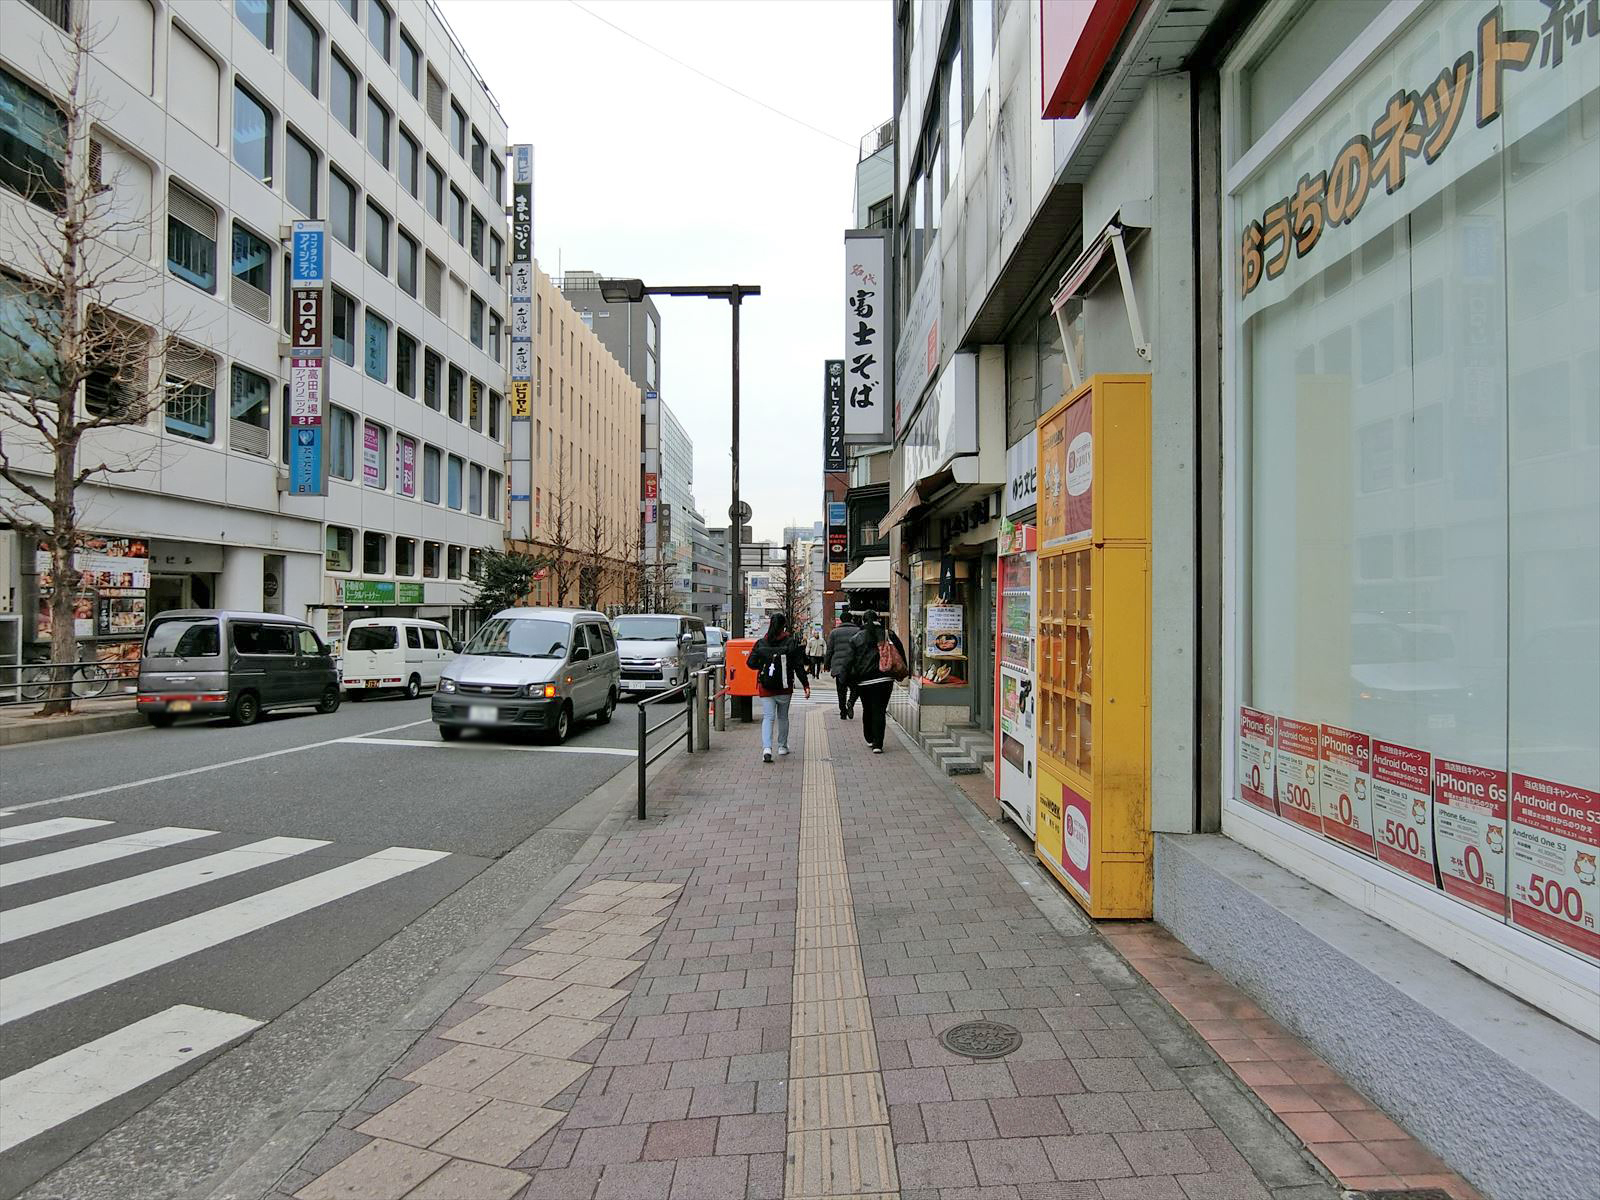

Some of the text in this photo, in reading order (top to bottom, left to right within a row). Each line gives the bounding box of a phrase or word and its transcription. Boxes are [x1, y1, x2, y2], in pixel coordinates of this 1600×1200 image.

[1242, 5, 1540, 298] おうちのネット
[515, 195, 531, 250] まんぷく
[299, 233, 310, 278] アイシティ
[310, 233, 318, 278] コンタクトの
[850, 264, 878, 286] 名代
[849, 289, 879, 408] 富士そば
[296, 369, 306, 415] アイクリニック
[308, 369, 318, 415] 高田馬場
[1241, 716, 1274, 736] iPhone 6s
[1279, 729, 1298, 741] Android
[1299, 733, 1309, 743] One
[1321, 734, 1354, 754] iPhone
[1357, 744, 1369, 760] 6s
[1373, 754, 1400, 769] Android
[1401, 762, 1416, 774] One
[1418, 766, 1429, 778] S3
[1436, 771, 1485, 797] iPhone
[1488, 783, 1507, 802] 6s
[1524, 779, 1592, 804] 当店独自キャンペーン
[1513, 791, 1557, 812] Android
[1559, 803, 1584, 820] One
[1512, 828, 1539, 843] Android
[1540, 837, 1555, 848] One
[1557, 841, 1567, 852] S3
